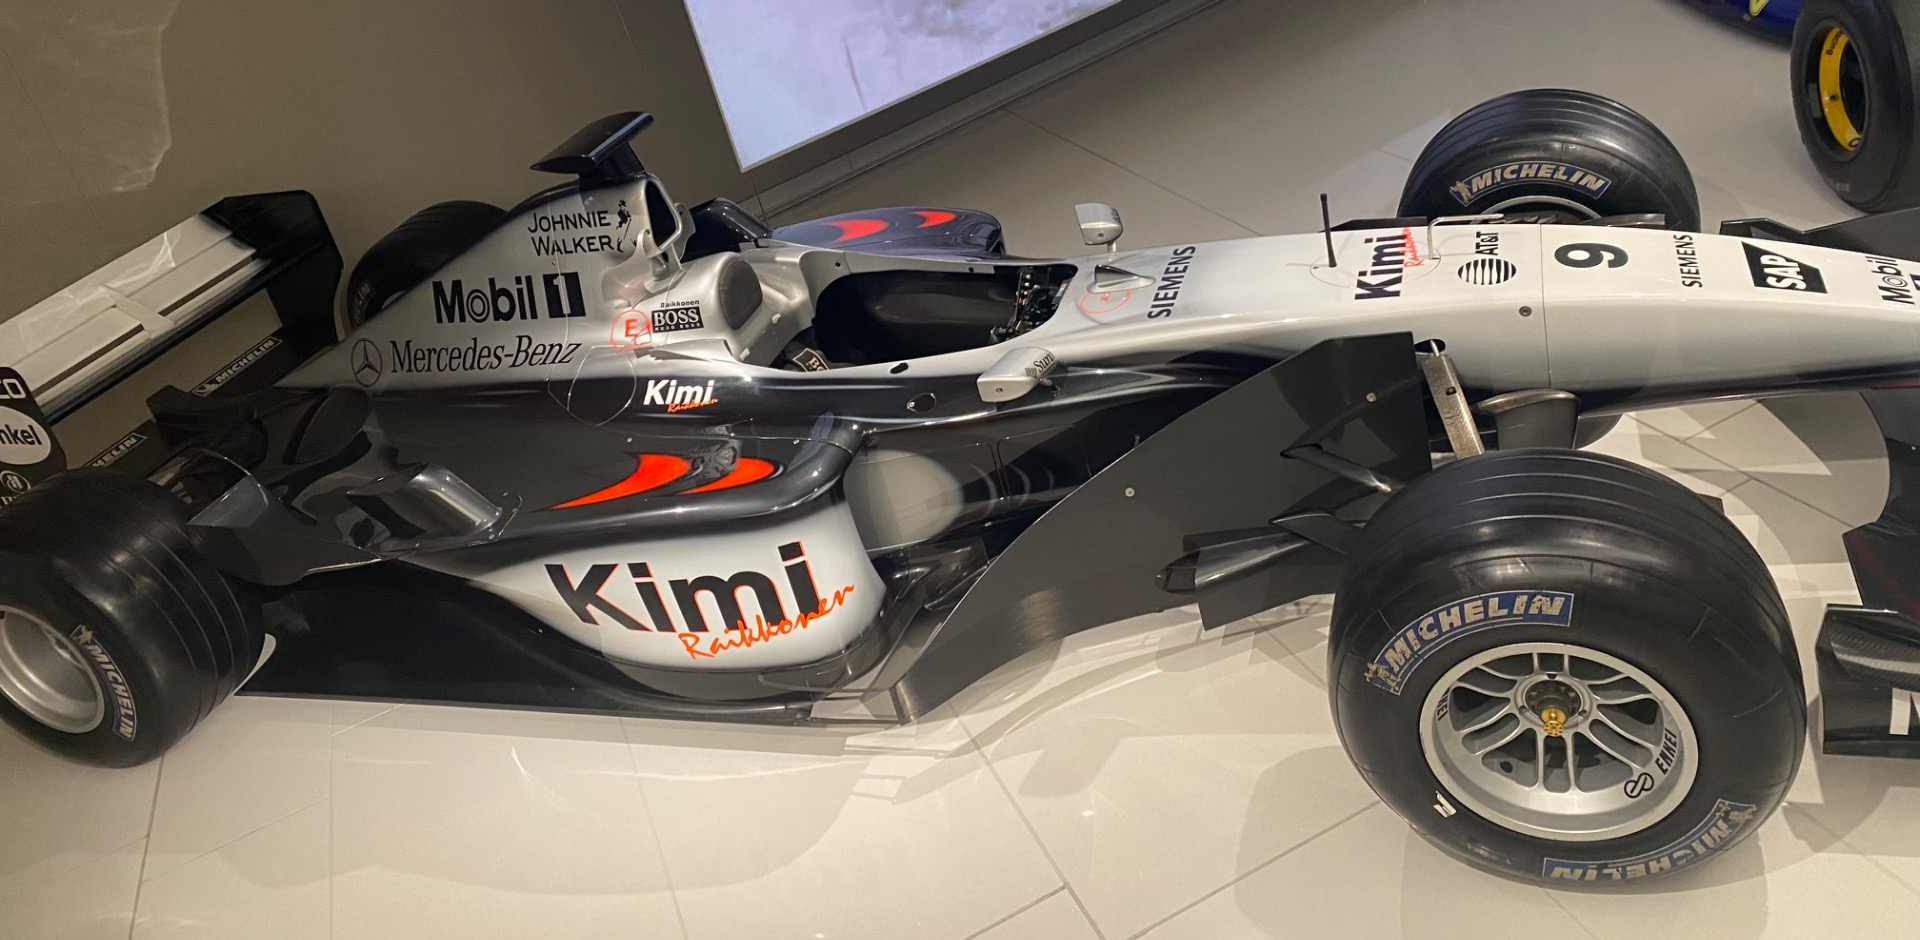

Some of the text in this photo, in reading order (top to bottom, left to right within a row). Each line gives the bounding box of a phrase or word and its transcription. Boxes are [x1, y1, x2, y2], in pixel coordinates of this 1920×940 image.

[1470, 164, 1605, 192] MICHELIN
[527, 210, 611, 233] JOHNNIE
[1474, 231, 1499, 256] AT&T
[530, 235, 615, 257] WALKER
[1354, 235, 1407, 300] Kimi
[1554, 242, 1629, 269] 9
[1673, 234, 1703, 288] SIEMENS
[1147, 246, 1196, 320] SIEMENS
[1760, 254, 1807, 291] SAP
[1865, 256, 1915, 305] Mobil
[432, 275, 538, 324] Mobil
[653, 308, 700, 327] BOSS
[660, 299, 700, 309] Raikkonen
[625, 319, 638, 337] E
[215, 339, 275, 383] MICHELIN
[389, 335, 583, 374] Mercedes-Benz
[643, 379, 715, 406] Kimi
[544, 540, 822, 633] Kimi
[678, 584, 855, 660] Raikkonen
[1384, 594, 1566, 674] MICHELIN
[86, 644, 135, 739] MICHELIN
[1654, 728, 1677, 776] ENKEI
[1550, 819, 1732, 881] MICHELIN
